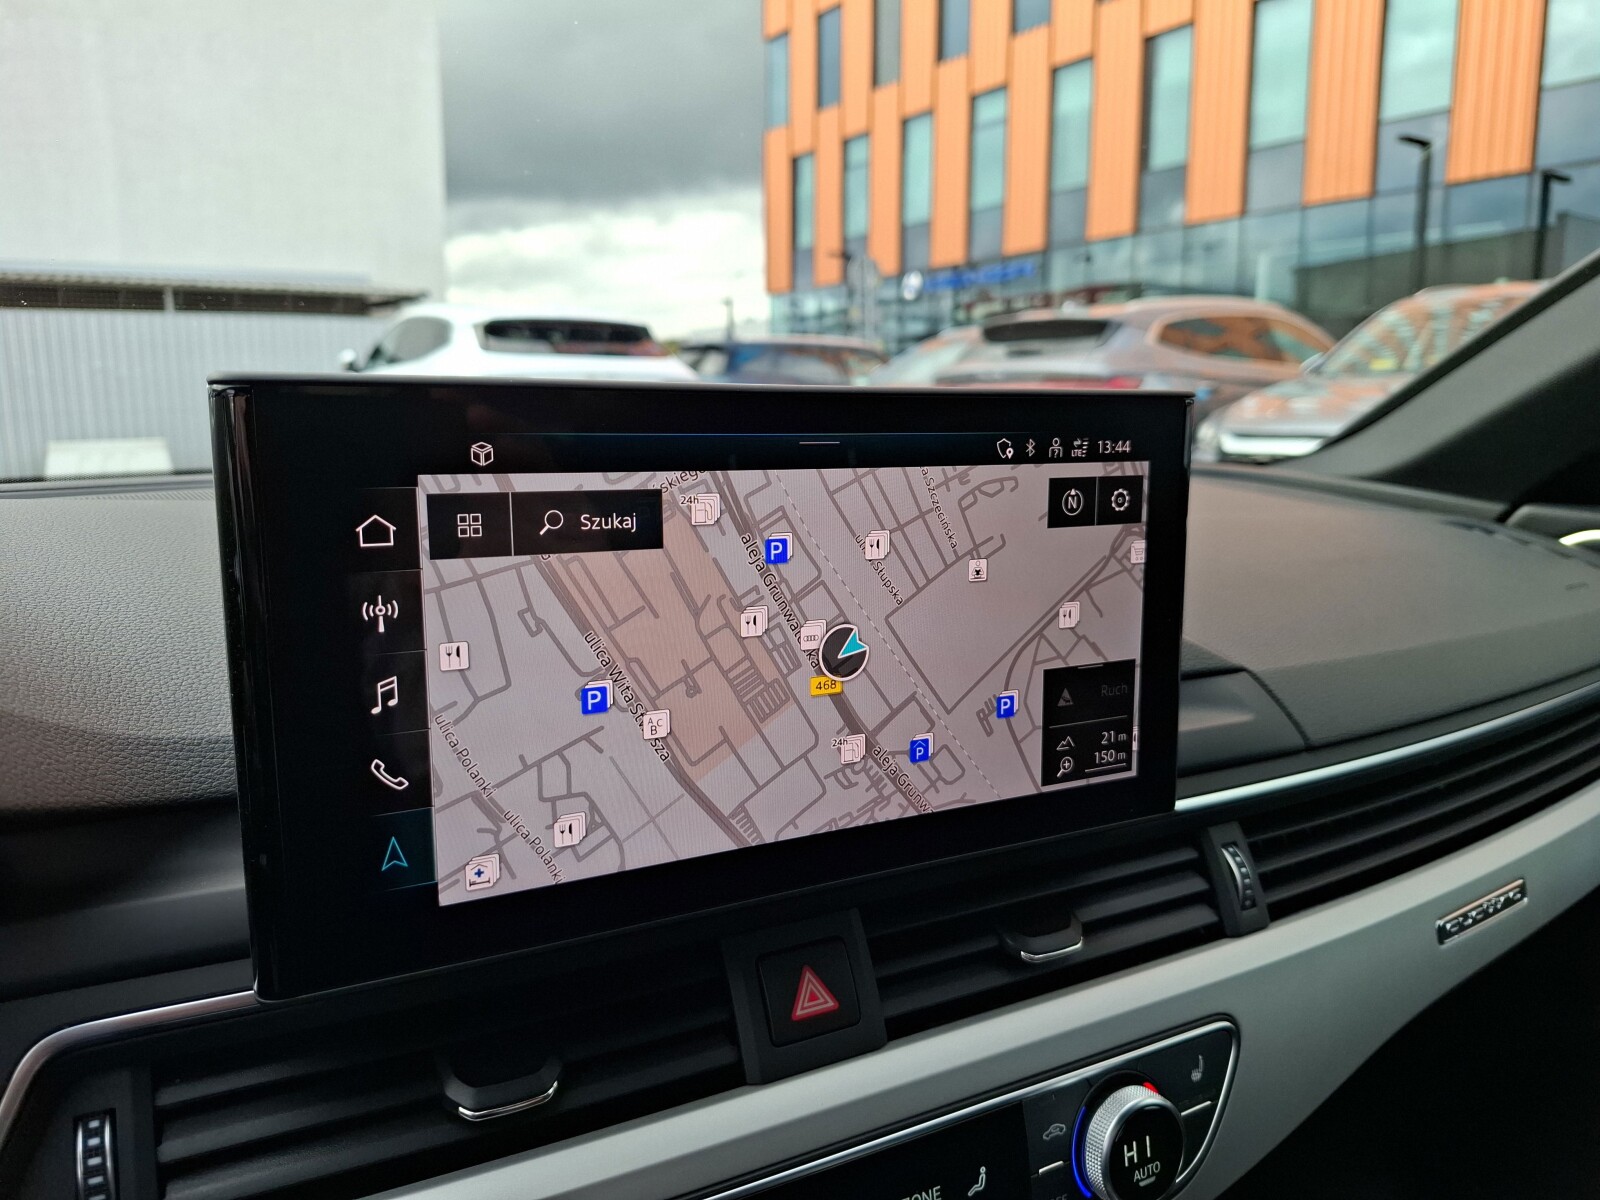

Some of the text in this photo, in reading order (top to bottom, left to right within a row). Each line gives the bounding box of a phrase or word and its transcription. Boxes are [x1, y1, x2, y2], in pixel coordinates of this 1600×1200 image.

[1071, 449, 1082, 457] LTE
[1098, 440, 1131, 453] 13:44
[680, 495, 699, 504] 24h
[924, 477, 958, 549] Szczecińska
[580, 512, 637, 533] Szukaj
[741, 534, 765, 572] aleja
[770, 542, 783, 560] P
[584, 632, 611, 668] ulica
[609, 664, 634, 703] Wita
[815, 680, 837, 690] 468
[1101, 683, 1128, 697] Ruch
[587, 691, 602, 711] P
[1000, 698, 1011, 715] P
[832, 738, 848, 747] 24h
[1101, 730, 1127, 744] 21 m
[434, 714, 497, 798] ulica Polanki
[873, 746, 898, 777] aleja
[1094, 749, 1126, 764] 150 m
[503, 810, 566, 884] ulica Polanki
[1133, 1160, 1161, 1183] AUTO
